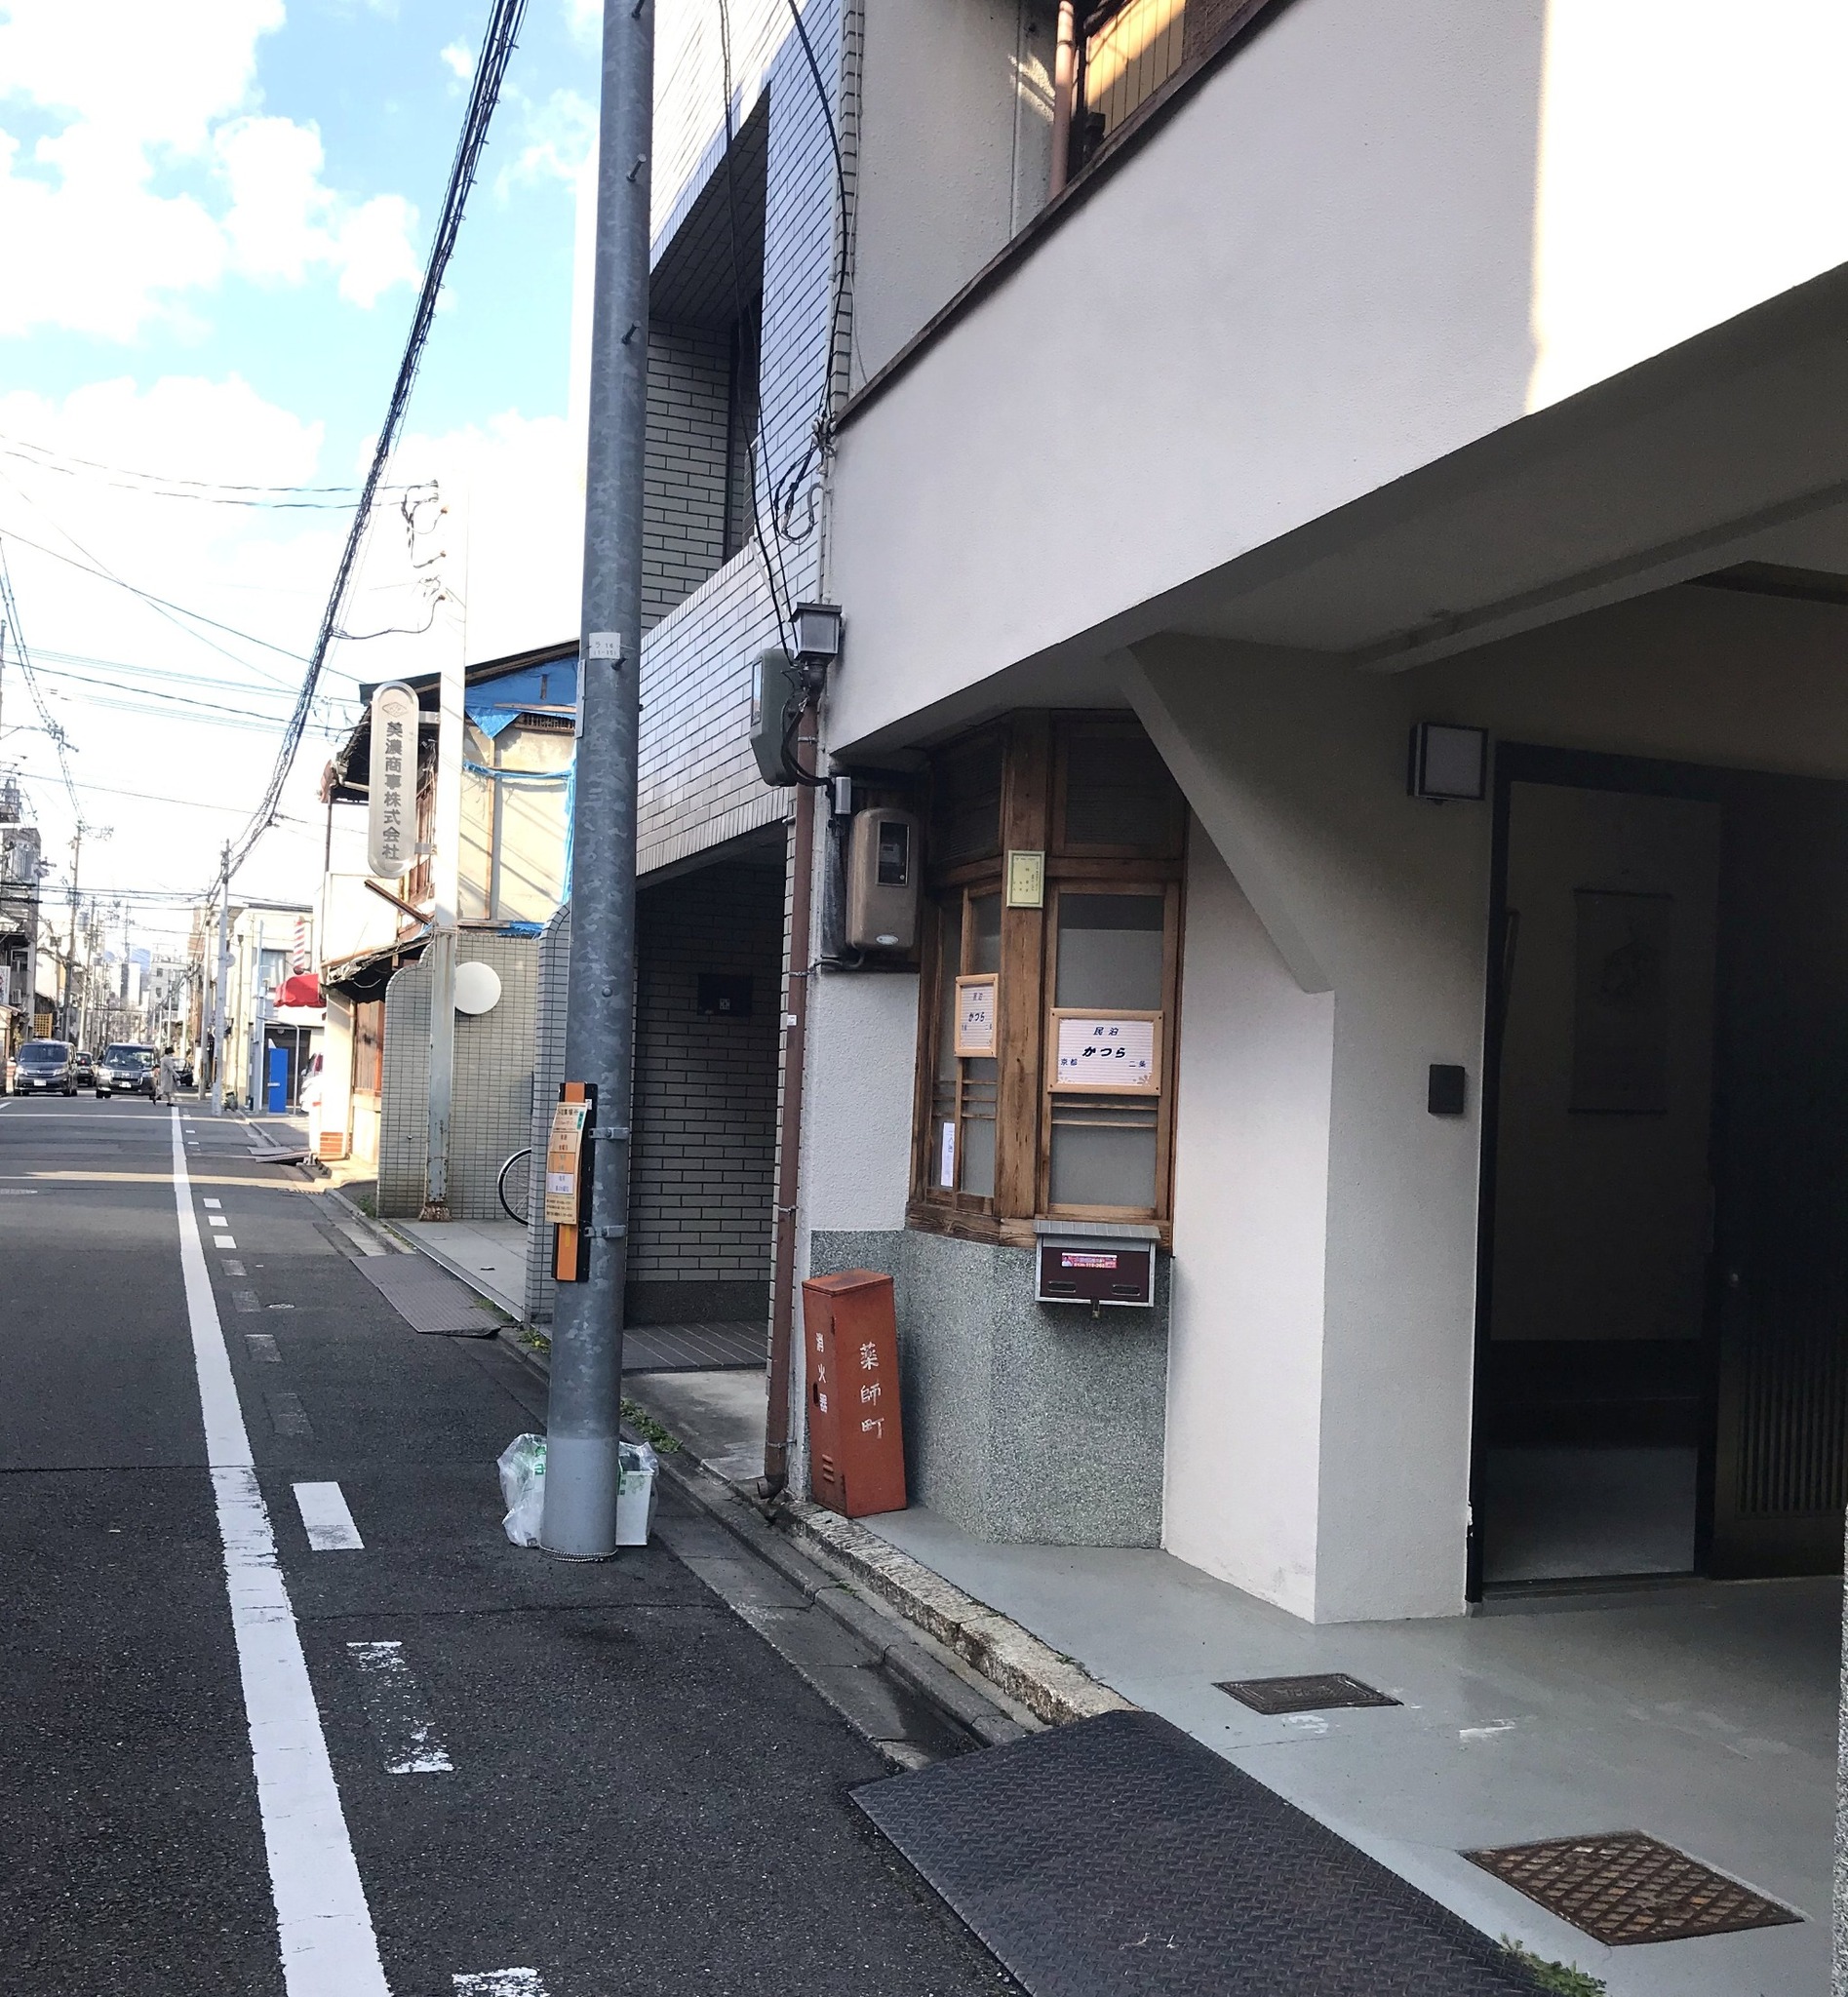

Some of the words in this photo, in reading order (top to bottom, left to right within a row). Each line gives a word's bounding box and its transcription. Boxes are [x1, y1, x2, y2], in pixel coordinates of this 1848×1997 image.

[381, 721, 404, 860] 美濃商事株式会社
[967, 1011, 985, 1023] かつら
[1092, 1026, 1121, 1037] 民泊
[1081, 1045, 1127, 1059] かつら
[1060, 1057, 1079, 1067] 京都
[1128, 1059, 1147, 1069] 二条
[815, 1332, 828, 1414] 消火器
[859, 1341, 885, 1439] 薬師町
